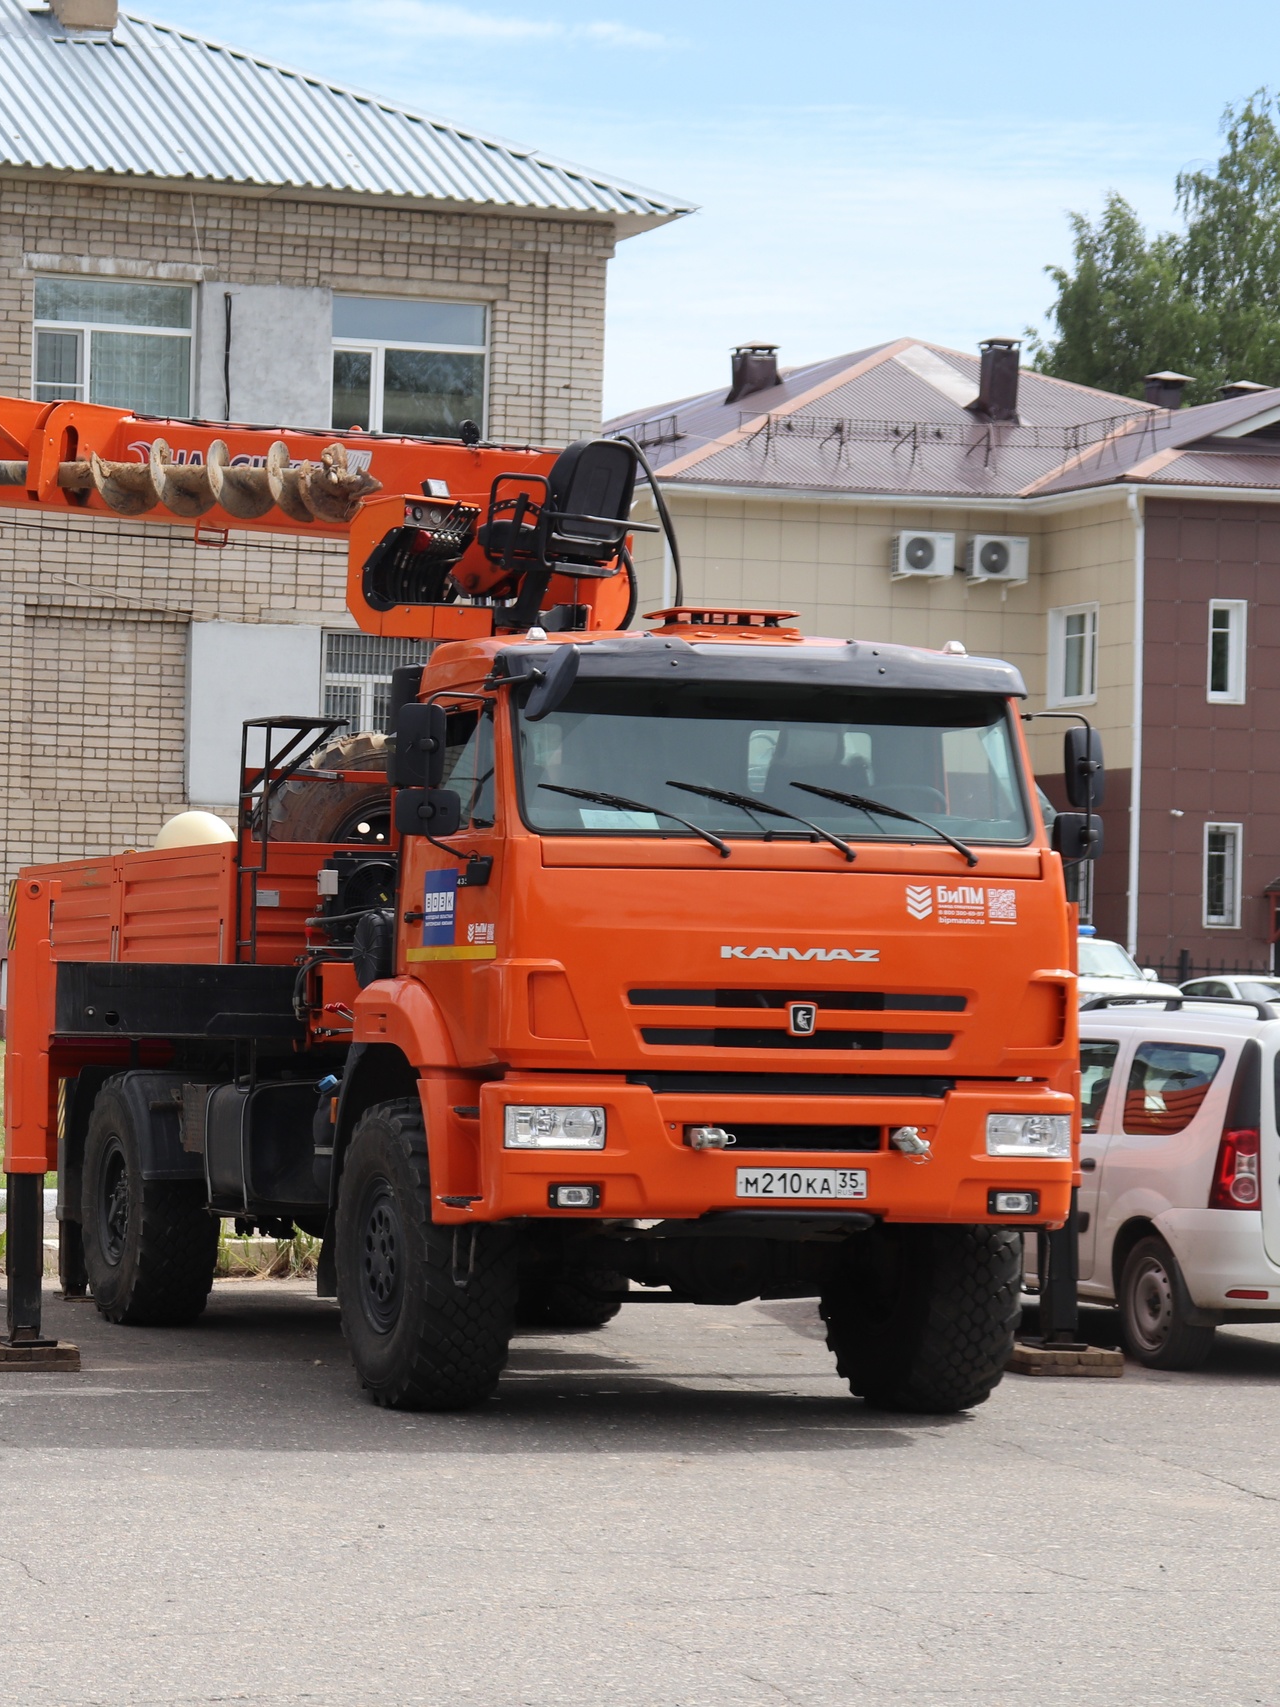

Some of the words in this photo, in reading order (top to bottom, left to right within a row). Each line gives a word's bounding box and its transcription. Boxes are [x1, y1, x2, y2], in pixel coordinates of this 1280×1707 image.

[426, 893, 454, 912] ВОЭК
[936, 885, 985, 905] БиПМ
[938, 916, 986, 925] bipmauto.ru
[720, 945, 881, 963] KAMAZ
[838, 1172, 859, 1189] 35
